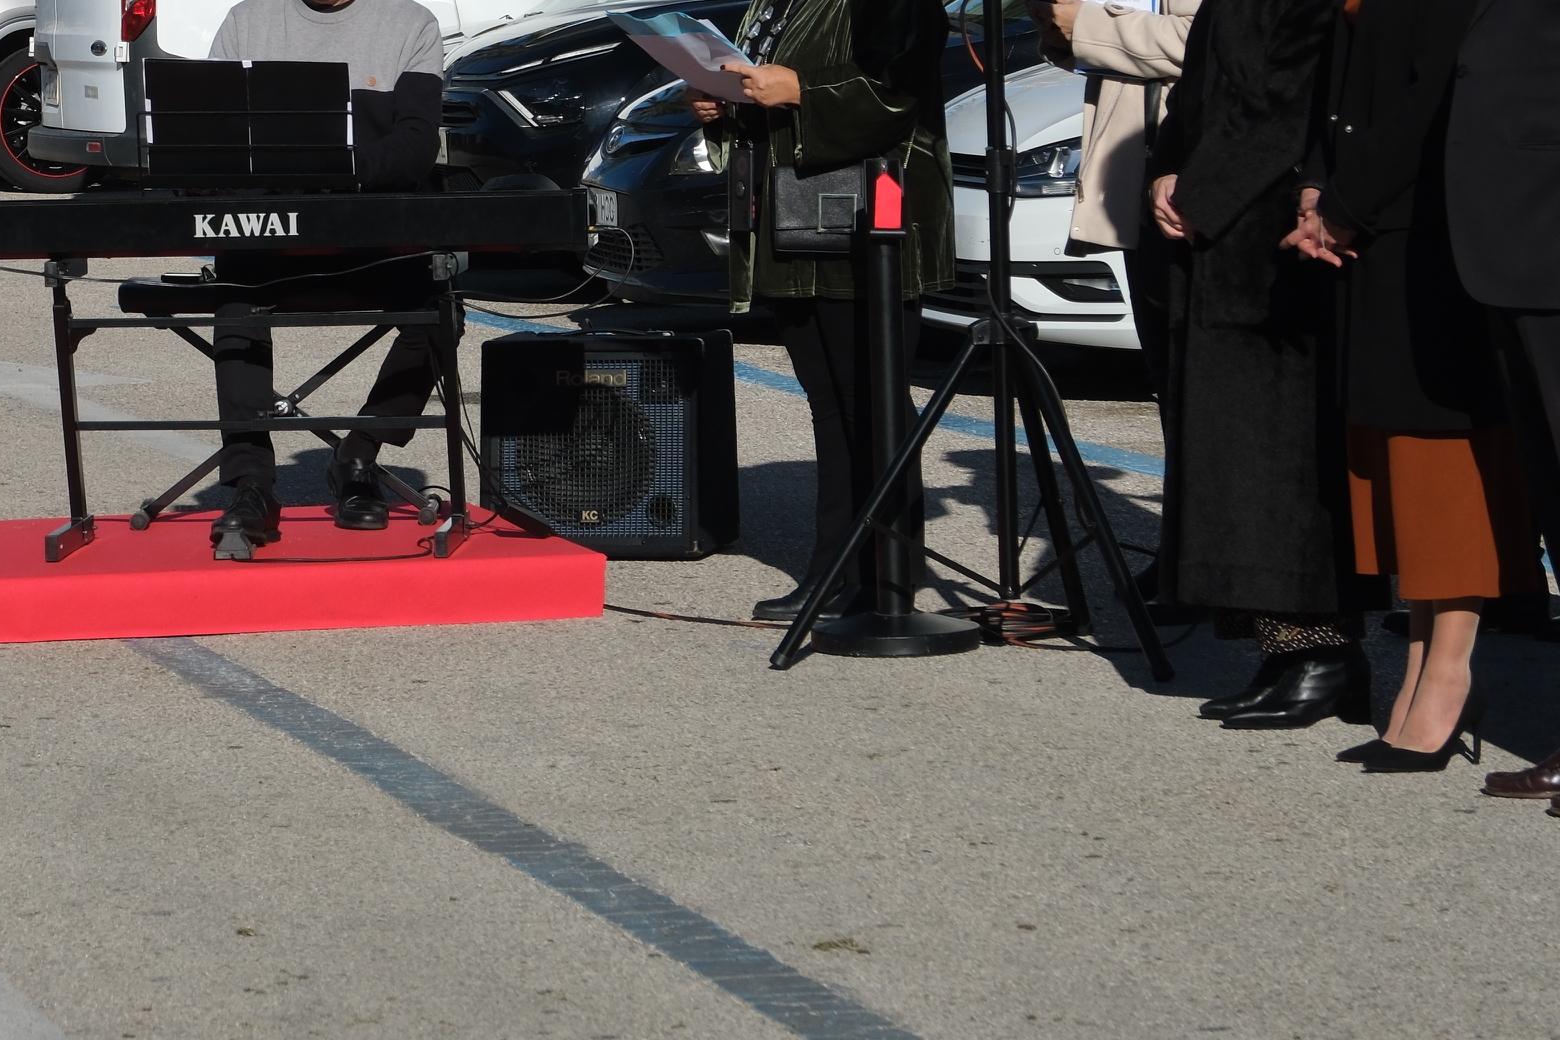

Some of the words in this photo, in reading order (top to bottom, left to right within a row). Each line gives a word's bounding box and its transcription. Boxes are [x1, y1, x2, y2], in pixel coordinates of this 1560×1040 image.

[193, 212, 300, 238] KAWAI
[556, 368, 627, 386] Roland
[582, 510, 599, 520] KC
